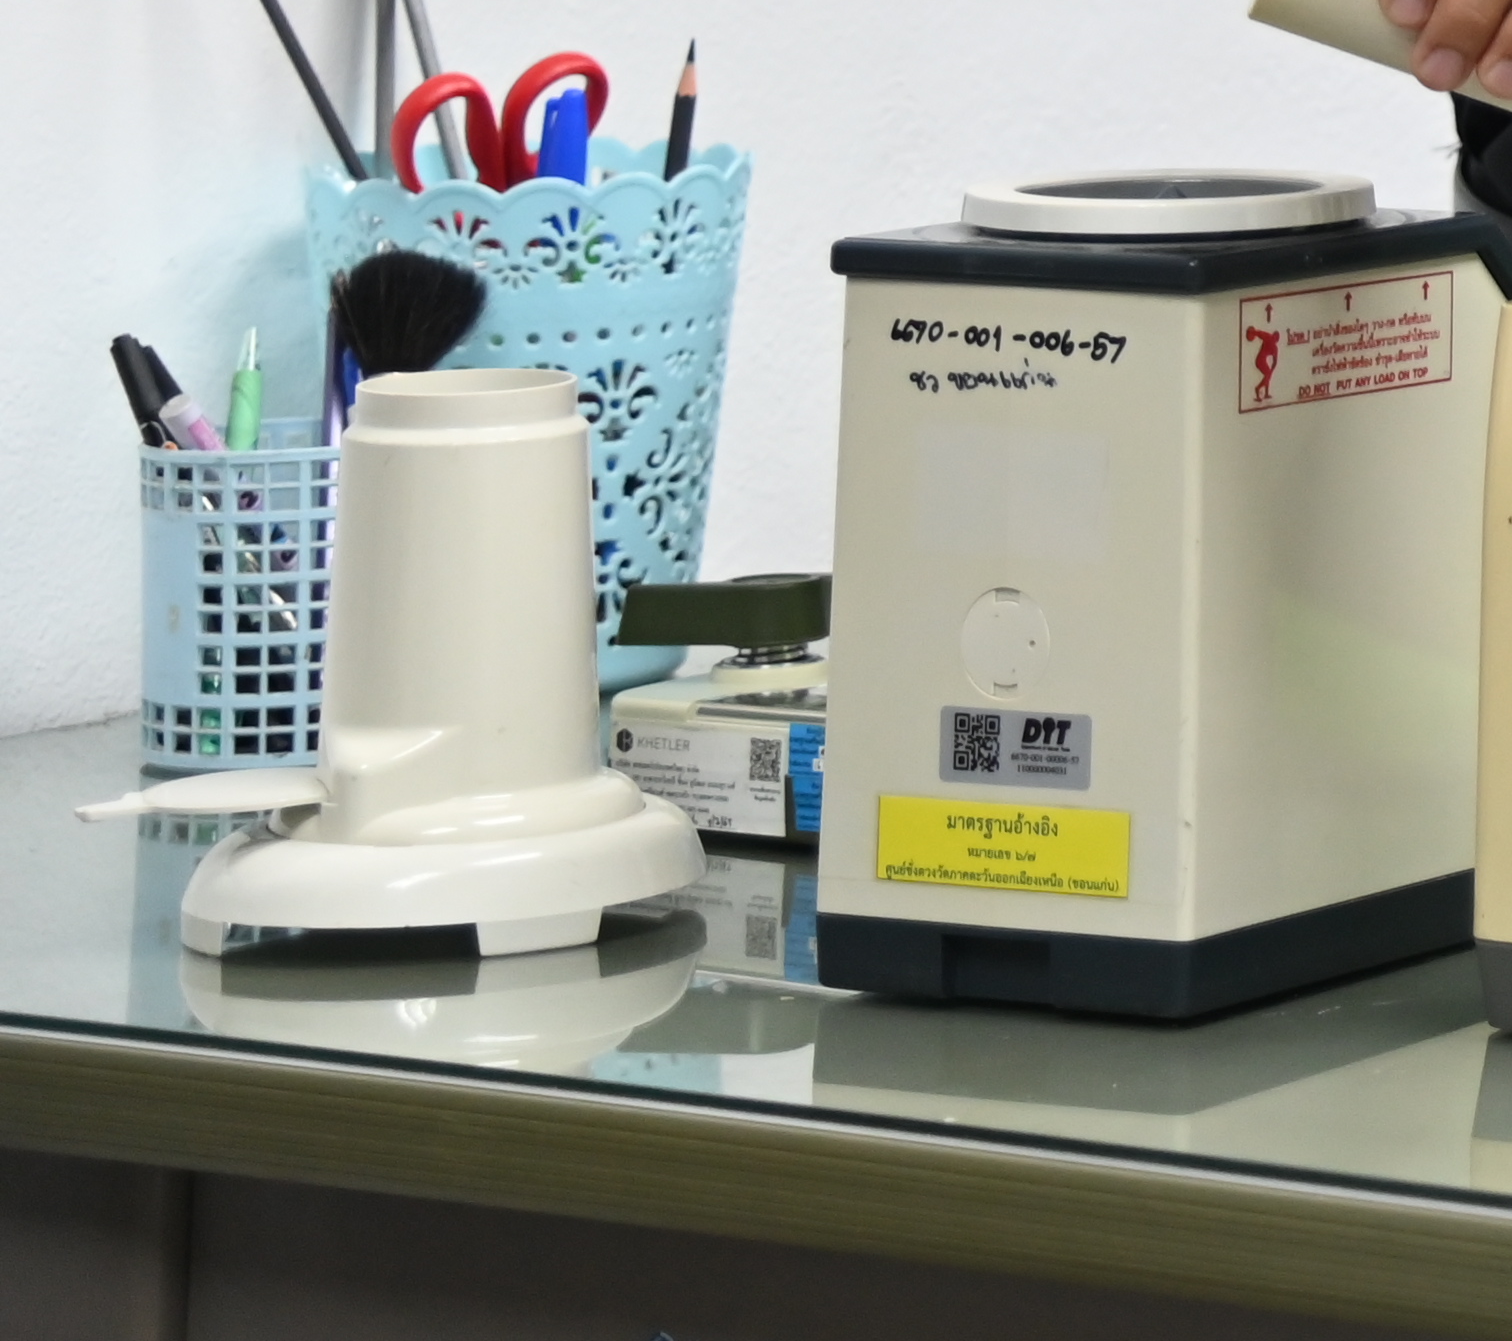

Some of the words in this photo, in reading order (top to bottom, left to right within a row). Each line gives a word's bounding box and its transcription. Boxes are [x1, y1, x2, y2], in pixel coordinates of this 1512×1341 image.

[1336, 379, 1353, 391] PUT
[1355, 376, 1372, 388] ANY
[1374, 371, 1396, 385] LOAD
[1398, 368, 1411, 381] ON
[1413, 366, 1429, 379] TOP
[636, 736, 691, 752] KHETLER
[946, 812, 1059, 839] มาตรฐานอ้างอิง
[966, 846, 1012, 861] หมายเลข
[885, 859, 1064, 889] ศูนย์ชั่งตวงวัดภาคตะวันออกเฉียงเหนือ
[1067, 875, 1120, 893] (ขอนแก่น)
